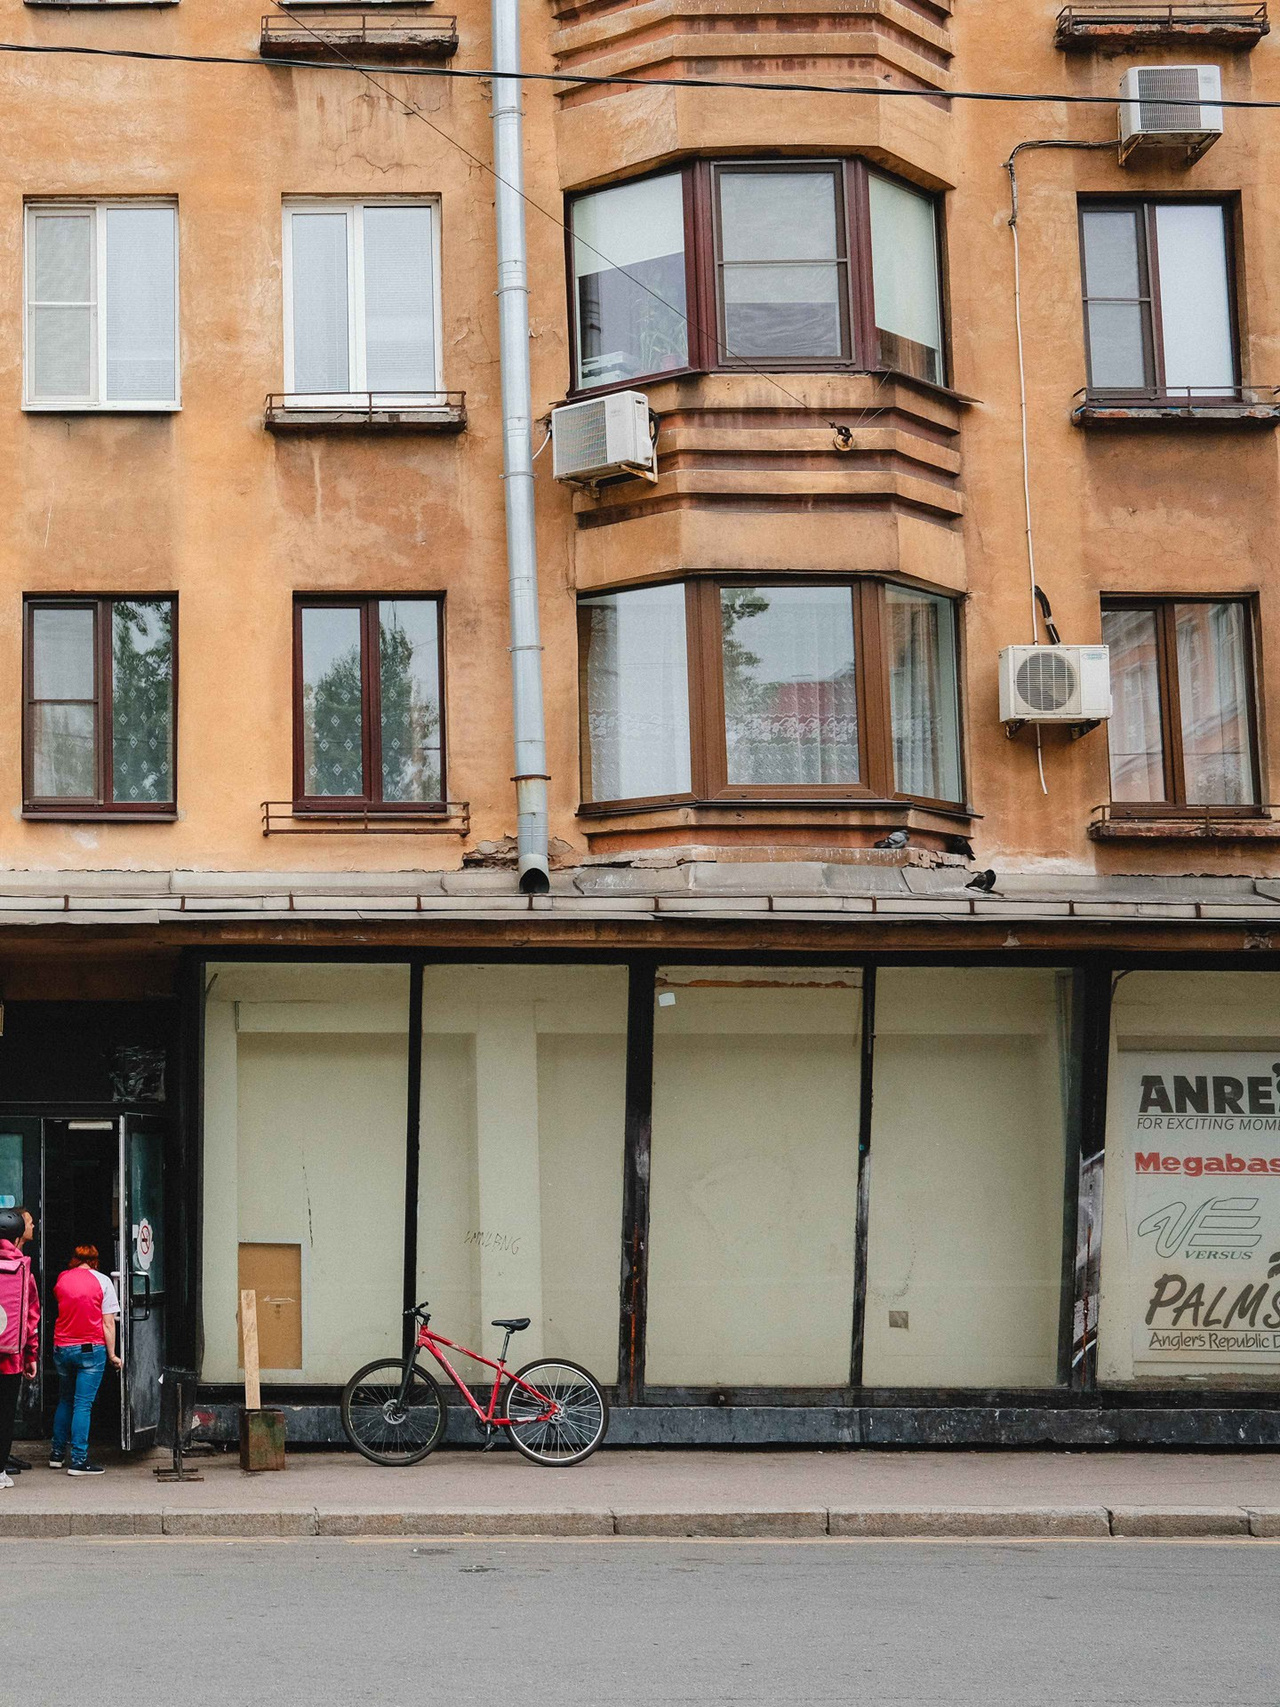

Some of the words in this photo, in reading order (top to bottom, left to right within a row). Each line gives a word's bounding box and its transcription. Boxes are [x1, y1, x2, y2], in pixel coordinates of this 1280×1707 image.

[1137, 1117, 1163, 1130] FOR
[1167, 1118, 1234, 1131] EXCITING
[1239, 1119, 1280, 1131] MOM
[1185, 1250, 1253, 1260] VERSUS
[1149, 1332, 1206, 1351] Angler's
[1209, 1332, 1269, 1351] Republic
